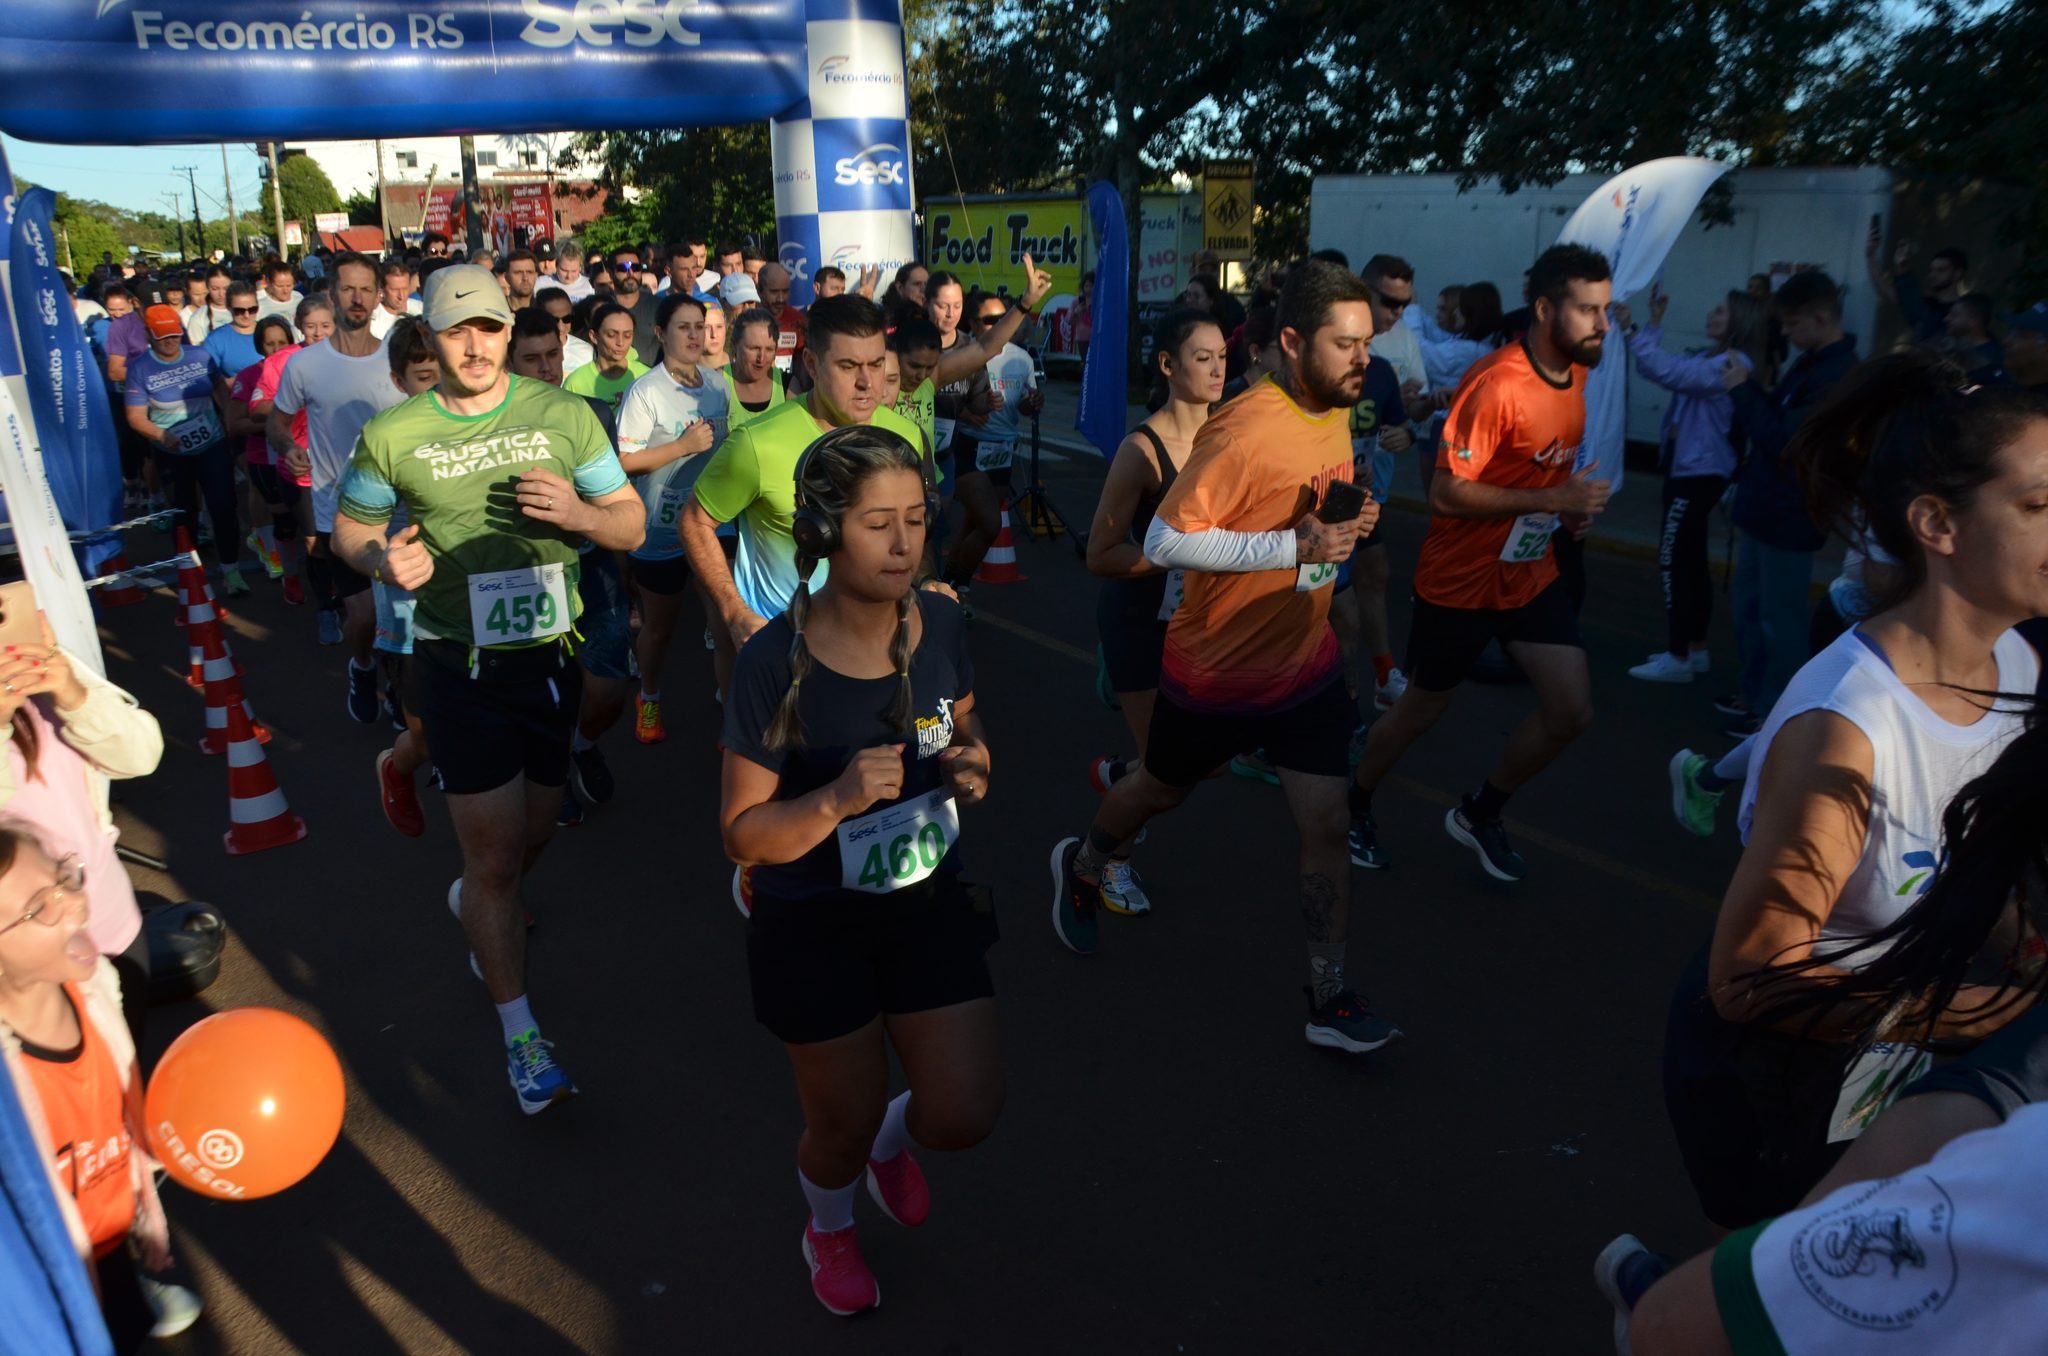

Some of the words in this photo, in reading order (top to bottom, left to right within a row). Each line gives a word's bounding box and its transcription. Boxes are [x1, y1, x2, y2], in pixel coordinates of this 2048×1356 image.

[132, 11, 396, 51] Fecomércio
[408, 13, 465, 50] RS
[825, 70, 892, 85] Fecomércio
[796, 169, 811, 181] RS
[930, 212, 994, 266] Food
[1006, 212, 1079, 266] Truck
[1207, 236, 1249, 249] ELEVADA
[1139, 274, 1174, 294] ETO
[180, 425, 211, 449] 858
[431, 446, 553, 481] NATALINA
[661, 503, 685, 524] 5
[1513, 532, 1550, 559] 52
[1659, 496, 1692, 567] GROWTH
[486, 591, 557, 636] 459
[858, 821, 946, 889] 460
[159, 1120, 246, 1199] CRESOL
